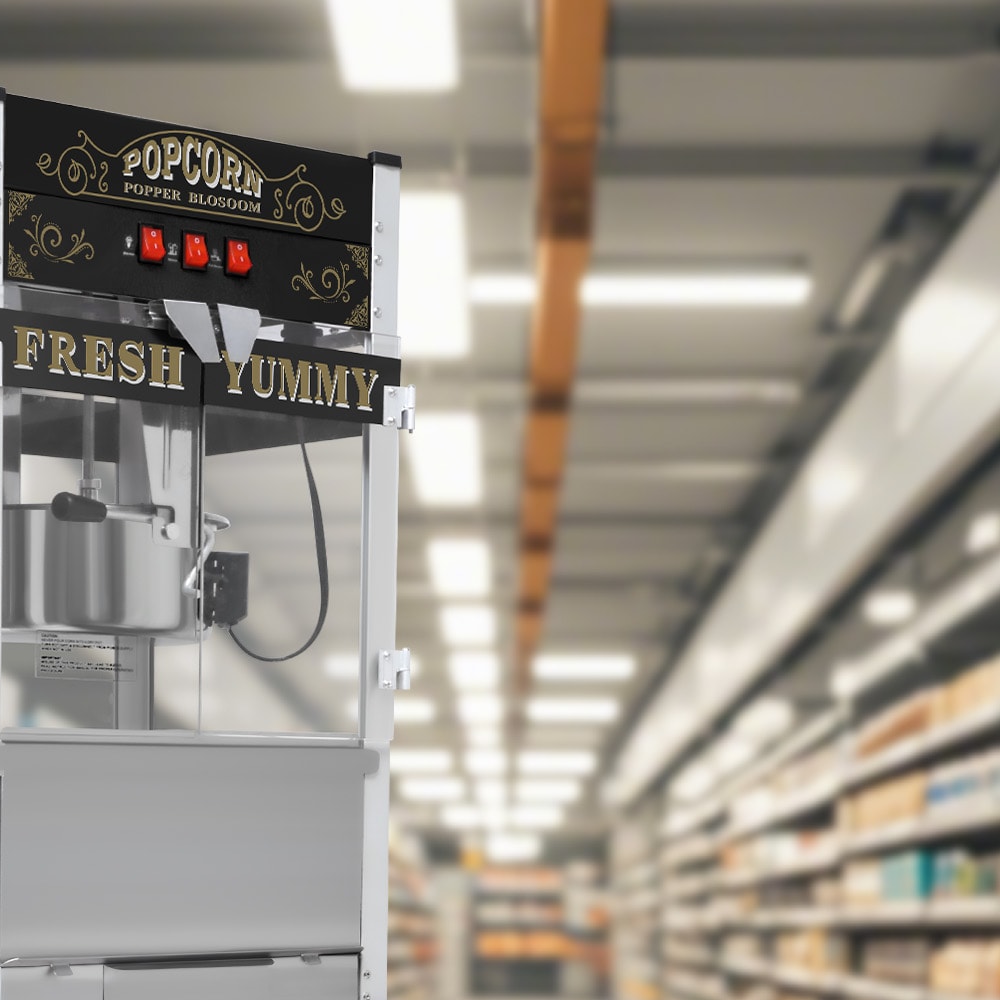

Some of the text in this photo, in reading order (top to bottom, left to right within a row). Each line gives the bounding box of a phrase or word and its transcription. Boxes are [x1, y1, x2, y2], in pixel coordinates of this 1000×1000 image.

[122, 135, 263, 198] POPCORN
[124, 182, 262, 214] POPPER BLOSOOM
[13, 325, 185, 391] FRESH
[220, 350, 379, 412] YUMMY
